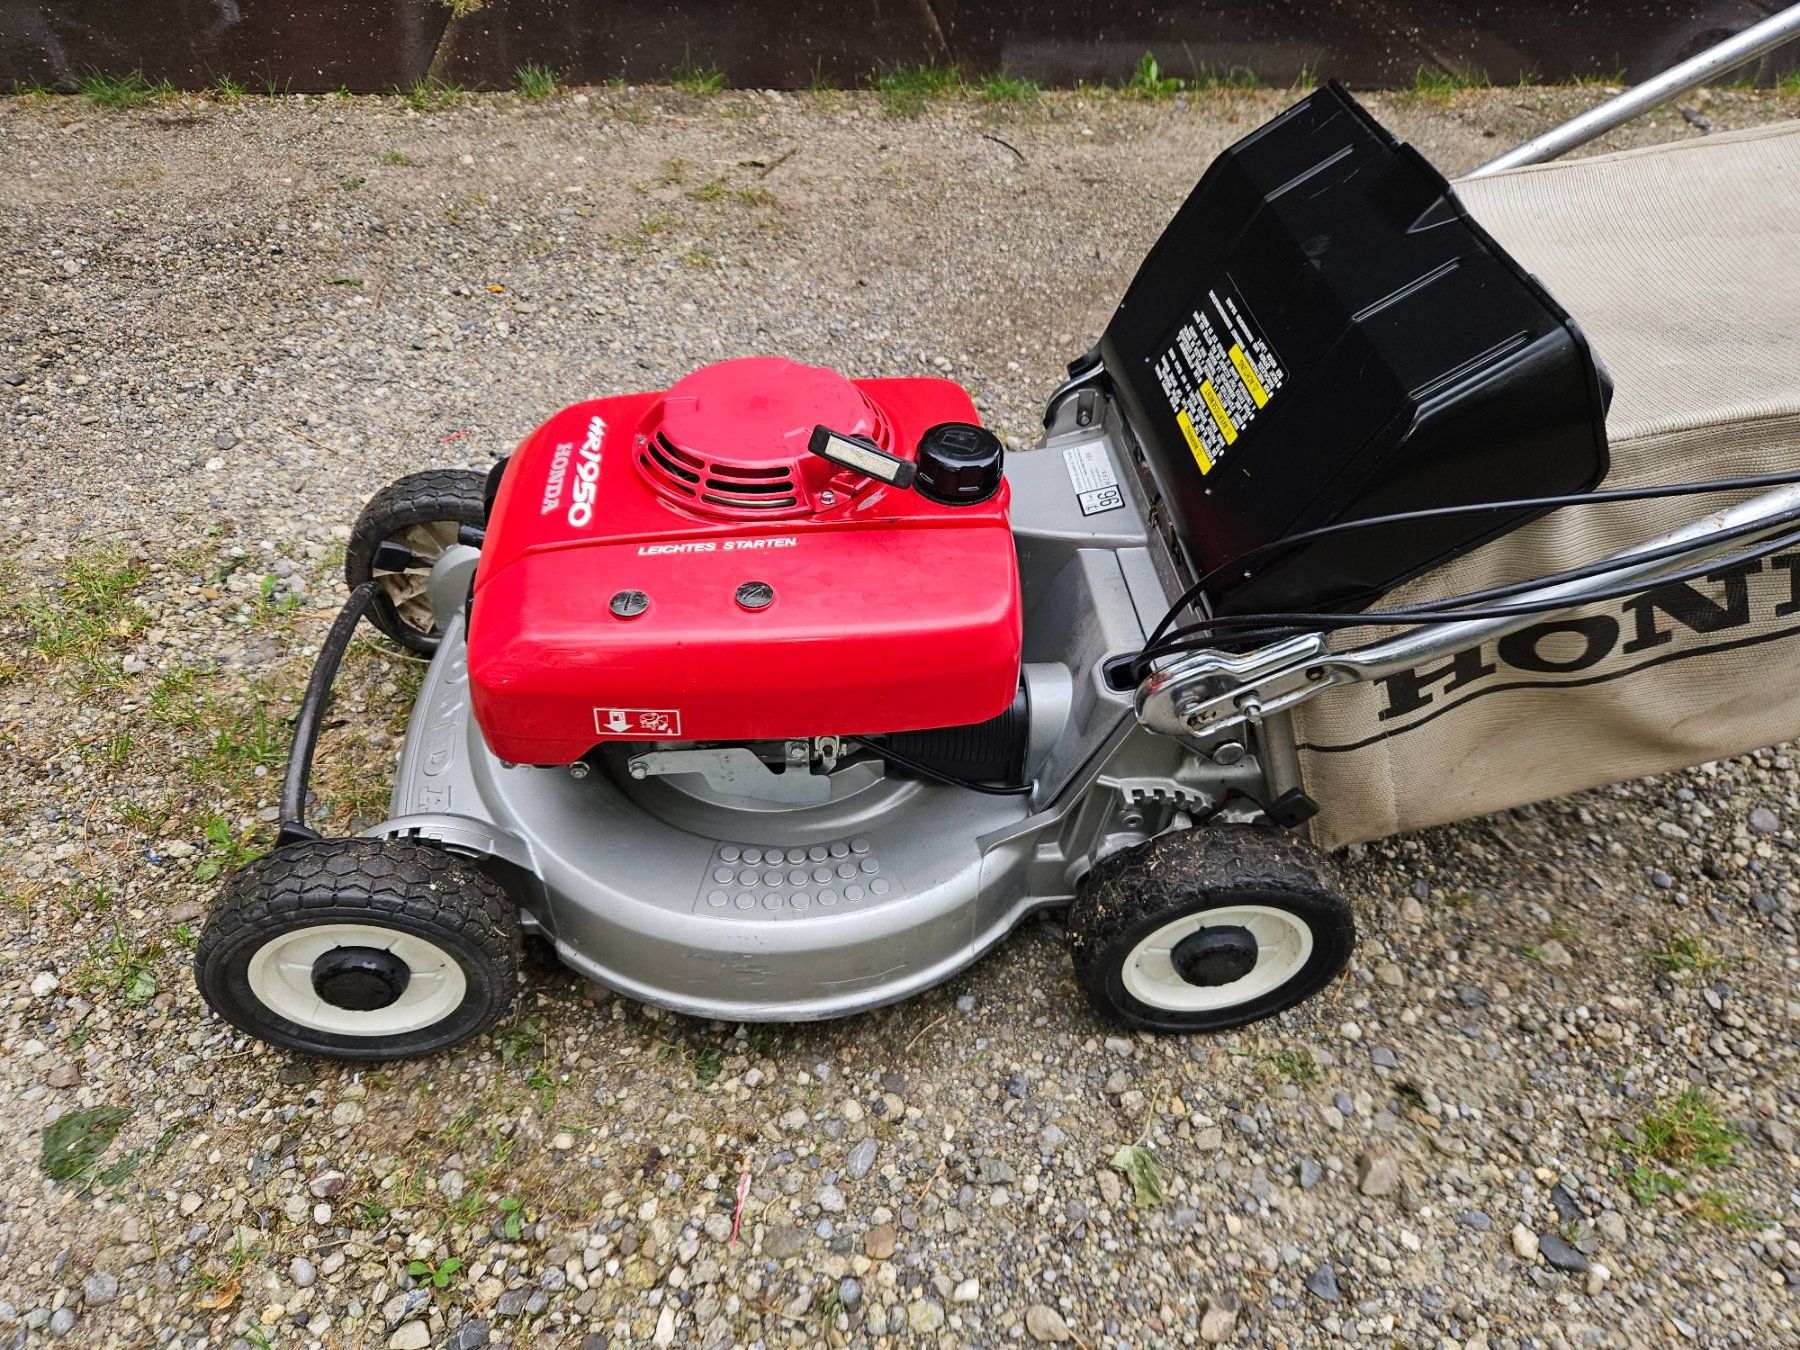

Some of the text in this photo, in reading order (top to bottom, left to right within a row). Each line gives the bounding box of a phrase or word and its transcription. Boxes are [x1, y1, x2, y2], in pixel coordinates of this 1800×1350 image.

[1236, 357, 1255, 387] ACHTUNG
[1203, 386, 1228, 431] AVERTISSEMENT
[1183, 424, 1199, 452] WARNING
[541, 442, 573, 514] HONDA
[1097, 490, 1120, 507] 96
[638, 537, 797, 556] LEICHTES STARTEN
